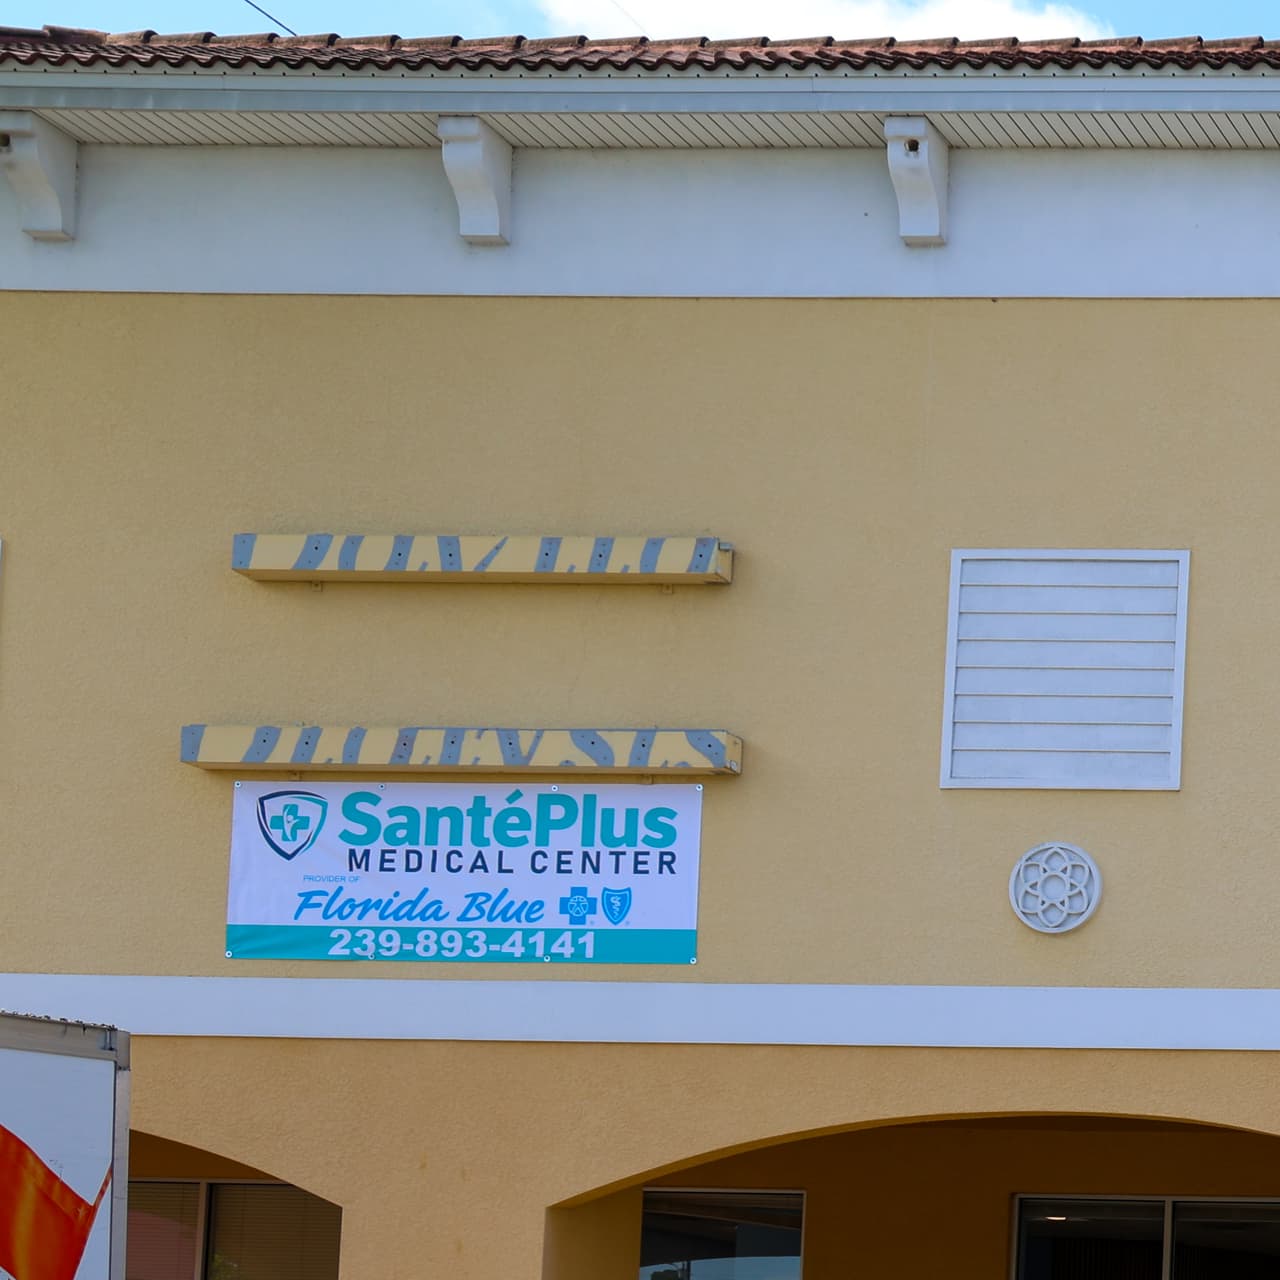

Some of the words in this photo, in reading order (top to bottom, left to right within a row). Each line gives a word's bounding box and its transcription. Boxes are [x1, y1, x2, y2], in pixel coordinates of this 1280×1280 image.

[339, 789, 678, 849] SantéPlus
[347, 849, 514, 873] MEDICAL
[530, 850, 677, 875] CENTER
[294, 886, 449, 922] Florida
[457, 888, 545, 923] Blue
[328, 928, 596, 958] 239-893-4141
